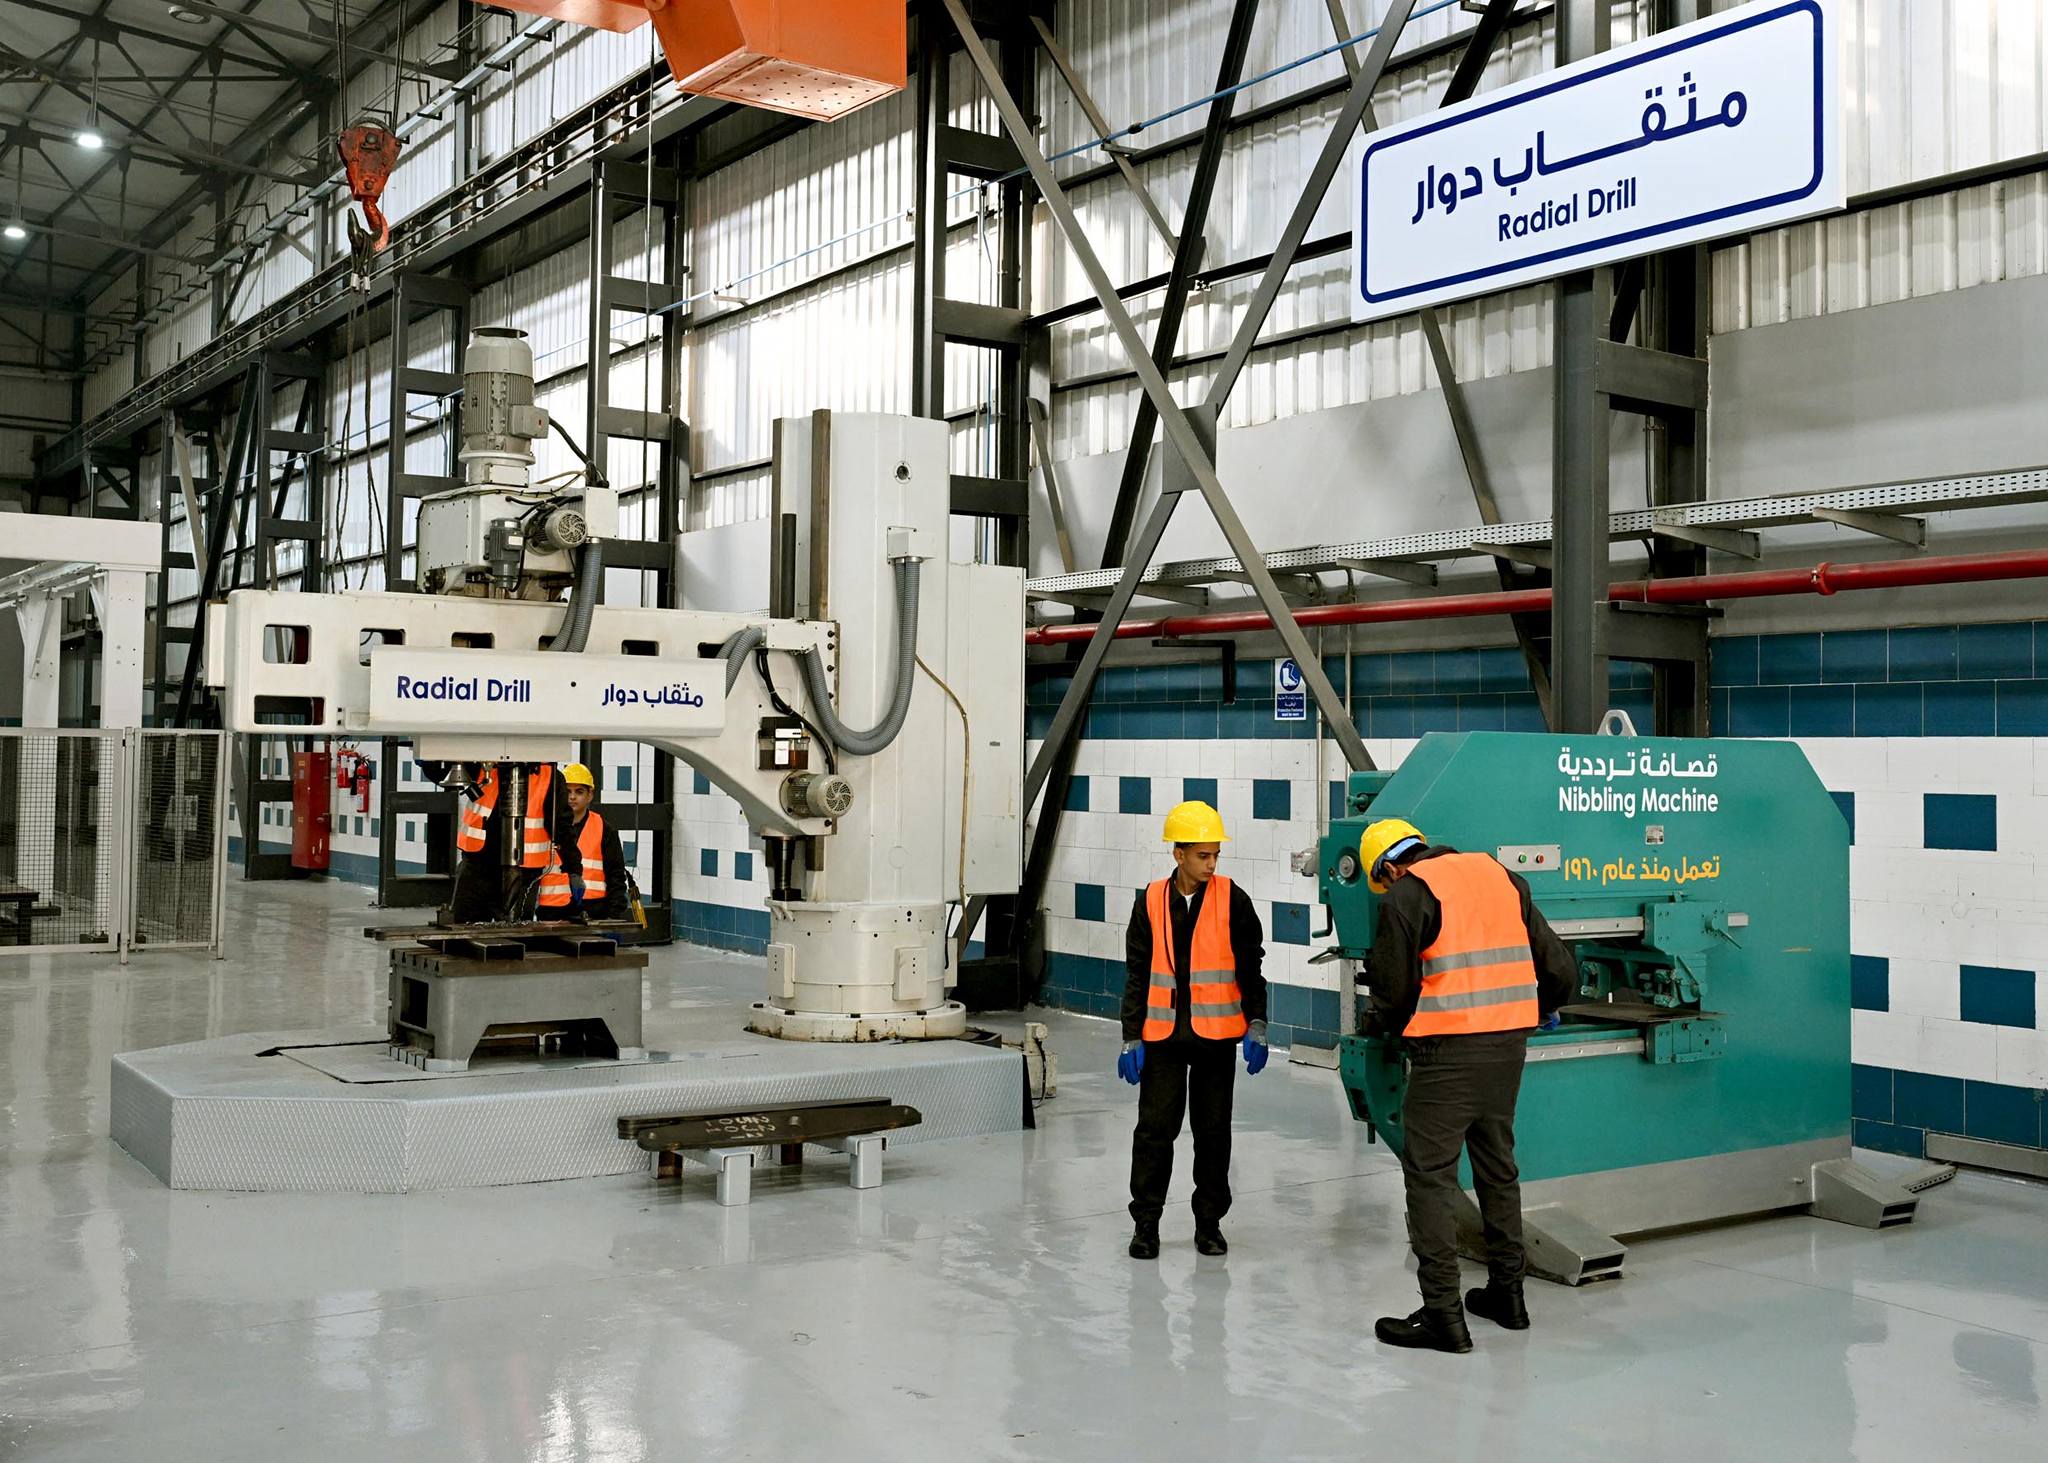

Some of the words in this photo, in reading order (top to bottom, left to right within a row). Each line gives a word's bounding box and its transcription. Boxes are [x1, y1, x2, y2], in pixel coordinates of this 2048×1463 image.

[1412, 164, 1483, 225] دوار
[1498, 193, 1578, 241] Radial
[1588, 176, 1636, 219] Drill
[396, 675, 478, 702] Radial
[486, 678, 531, 703] Drill
[601, 683, 639, 707] دوار
[643, 682, 704, 708] مثقاب
[1557, 746, 1636, 782] ترددية
[1639, 747, 1718, 778] قصافة
[1558, 785, 1636, 819] Nibbling
[1641, 786, 1719, 813] Machine
[1564, 857, 1598, 881] ١٩٦٠
[1601, 857, 1636, 887] عام
[1639, 856, 1671, 882] منذ
[1673, 855, 1721, 885] تعمل
